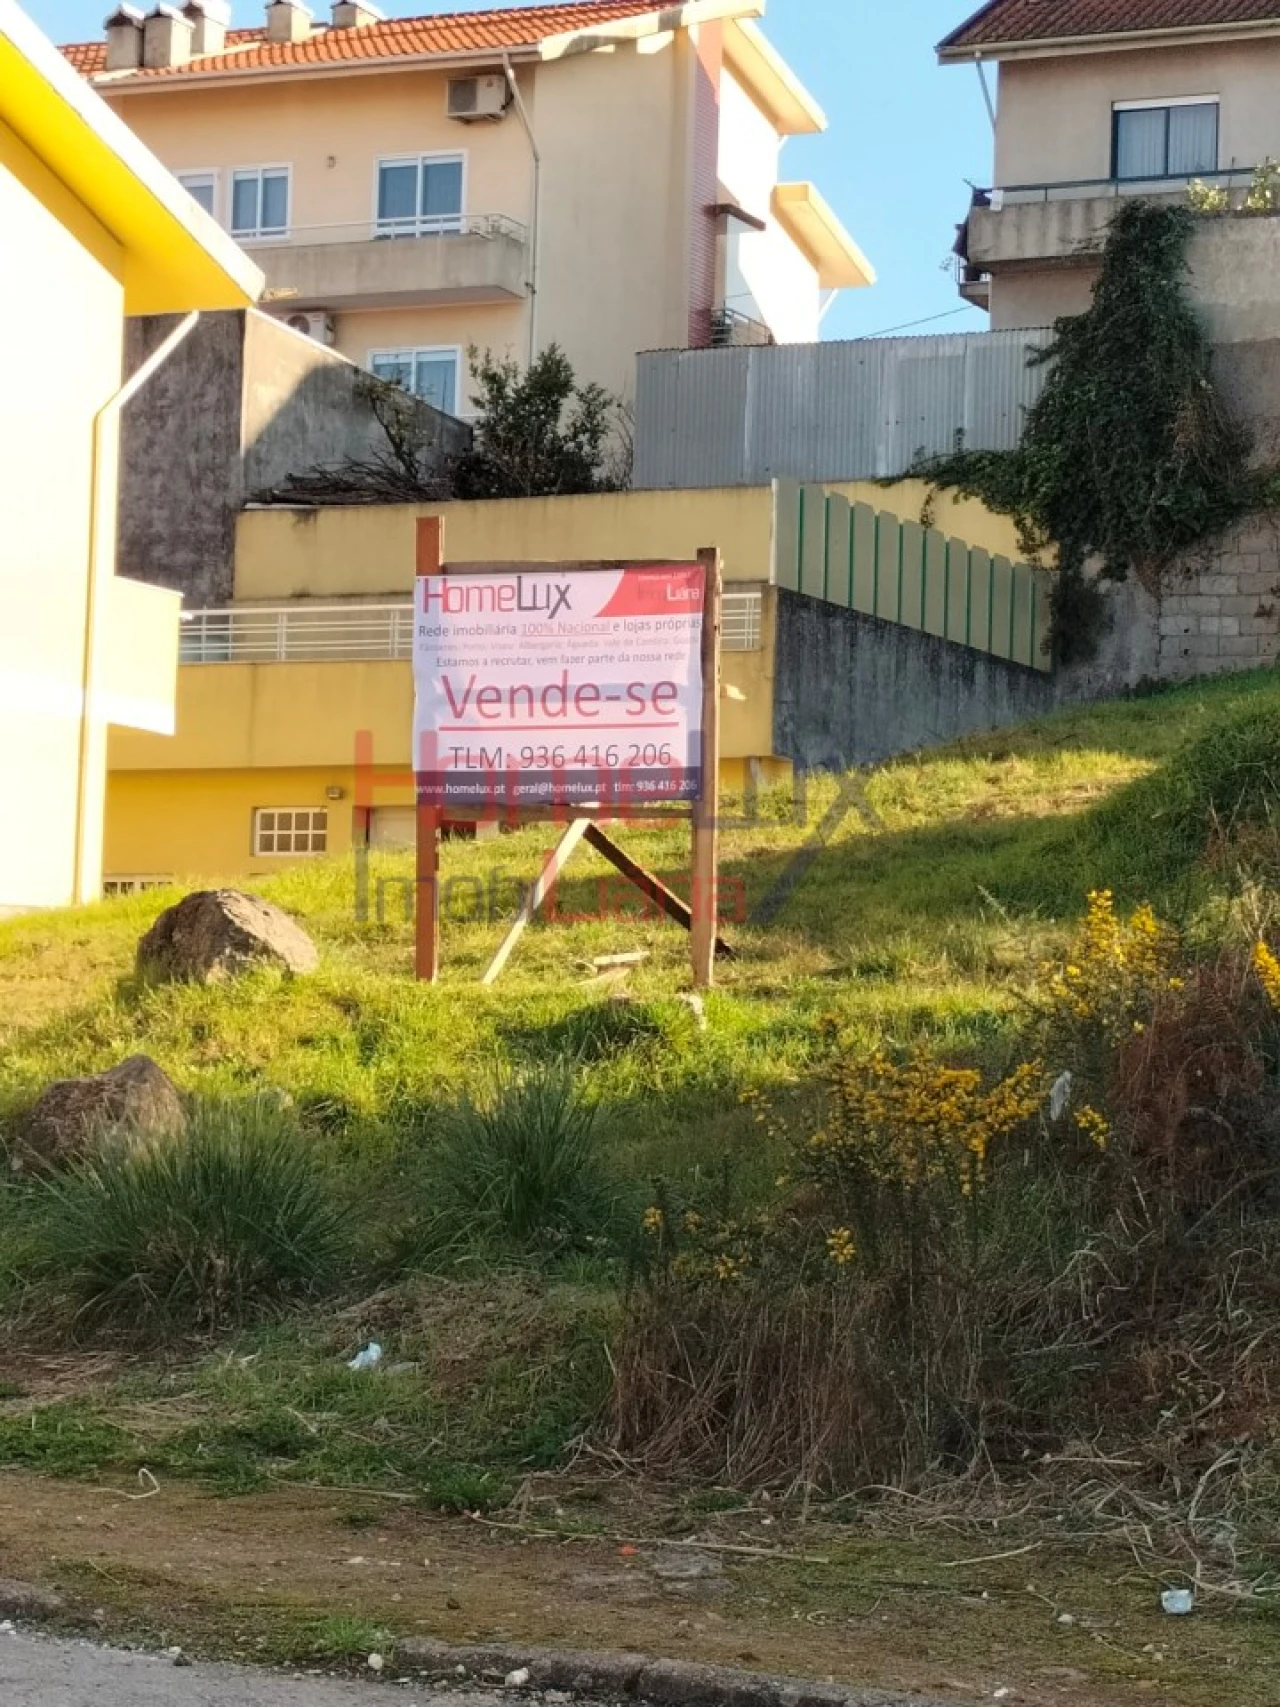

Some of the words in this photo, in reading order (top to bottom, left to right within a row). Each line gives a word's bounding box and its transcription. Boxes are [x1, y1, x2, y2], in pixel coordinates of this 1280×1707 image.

[422, 575, 572, 619] HomeLux
[419, 625, 449, 637] Rede
[522, 621, 553, 635] 100%
[558, 621, 610, 634] Nacional
[613, 622, 620, 632] e
[624, 620, 651, 634] lojas
[436, 656, 479, 668] Estamos
[537, 655, 557, 665] vem
[560, 653, 584, 664] fazer
[587, 653, 615, 665] parte
[618, 651, 630, 662] da
[633, 652, 662, 662] nossa
[441, 669, 679, 719] Vende-se
[449, 745, 511, 769] TLM:
[521, 744, 565, 769] 936
[574, 744, 619, 768] 416
[629, 743, 672, 767] 206
[416, 782, 505, 796] www.homelux.pt
[514, 782, 606, 797] geral@homelux.pt
[636, 780, 656, 793] 936
[657, 780, 676, 792] 416
[679, 779, 698, 792] 206
